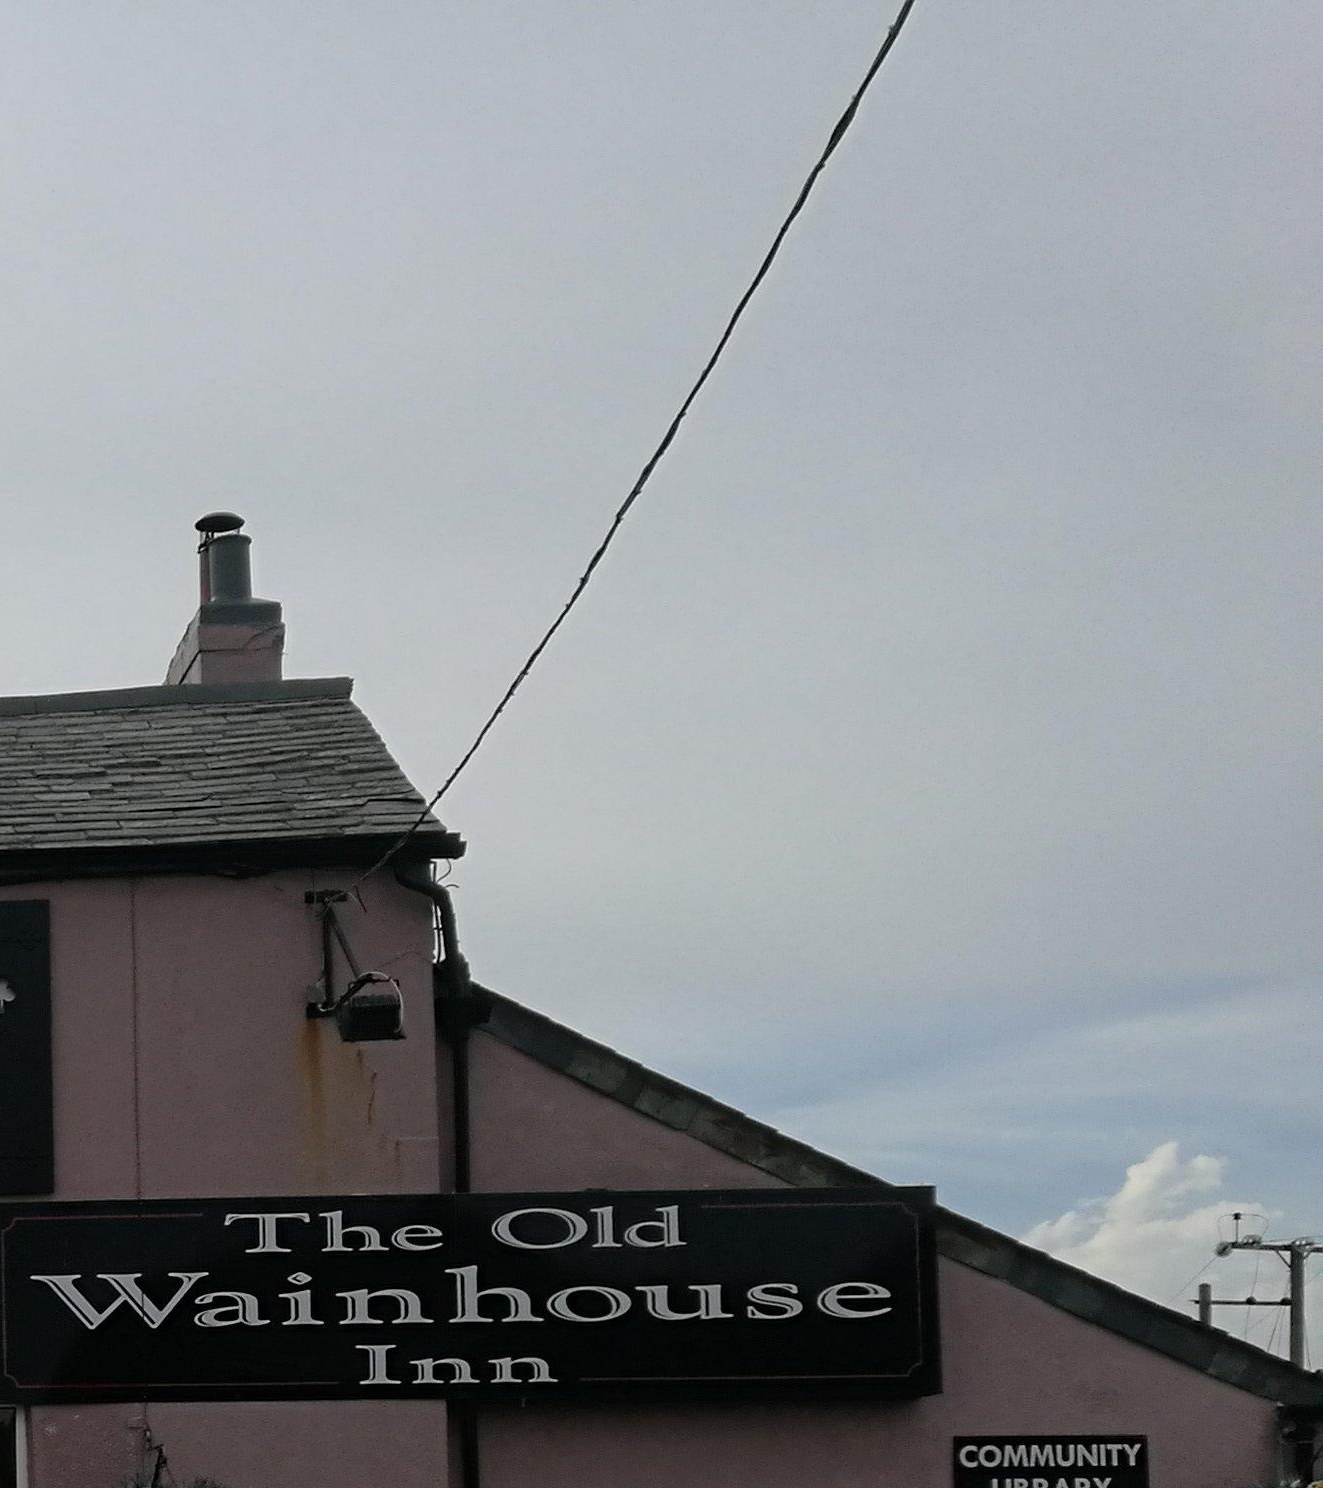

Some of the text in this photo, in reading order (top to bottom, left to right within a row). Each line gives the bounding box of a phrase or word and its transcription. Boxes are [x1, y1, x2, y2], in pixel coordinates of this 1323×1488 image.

[223, 1204, 688, 1254] The Old
[29, 1264, 893, 1330] Wainhouse
[355, 1344, 559, 1386] Inn
[959, 1443, 1142, 1468] COMMUNITY
